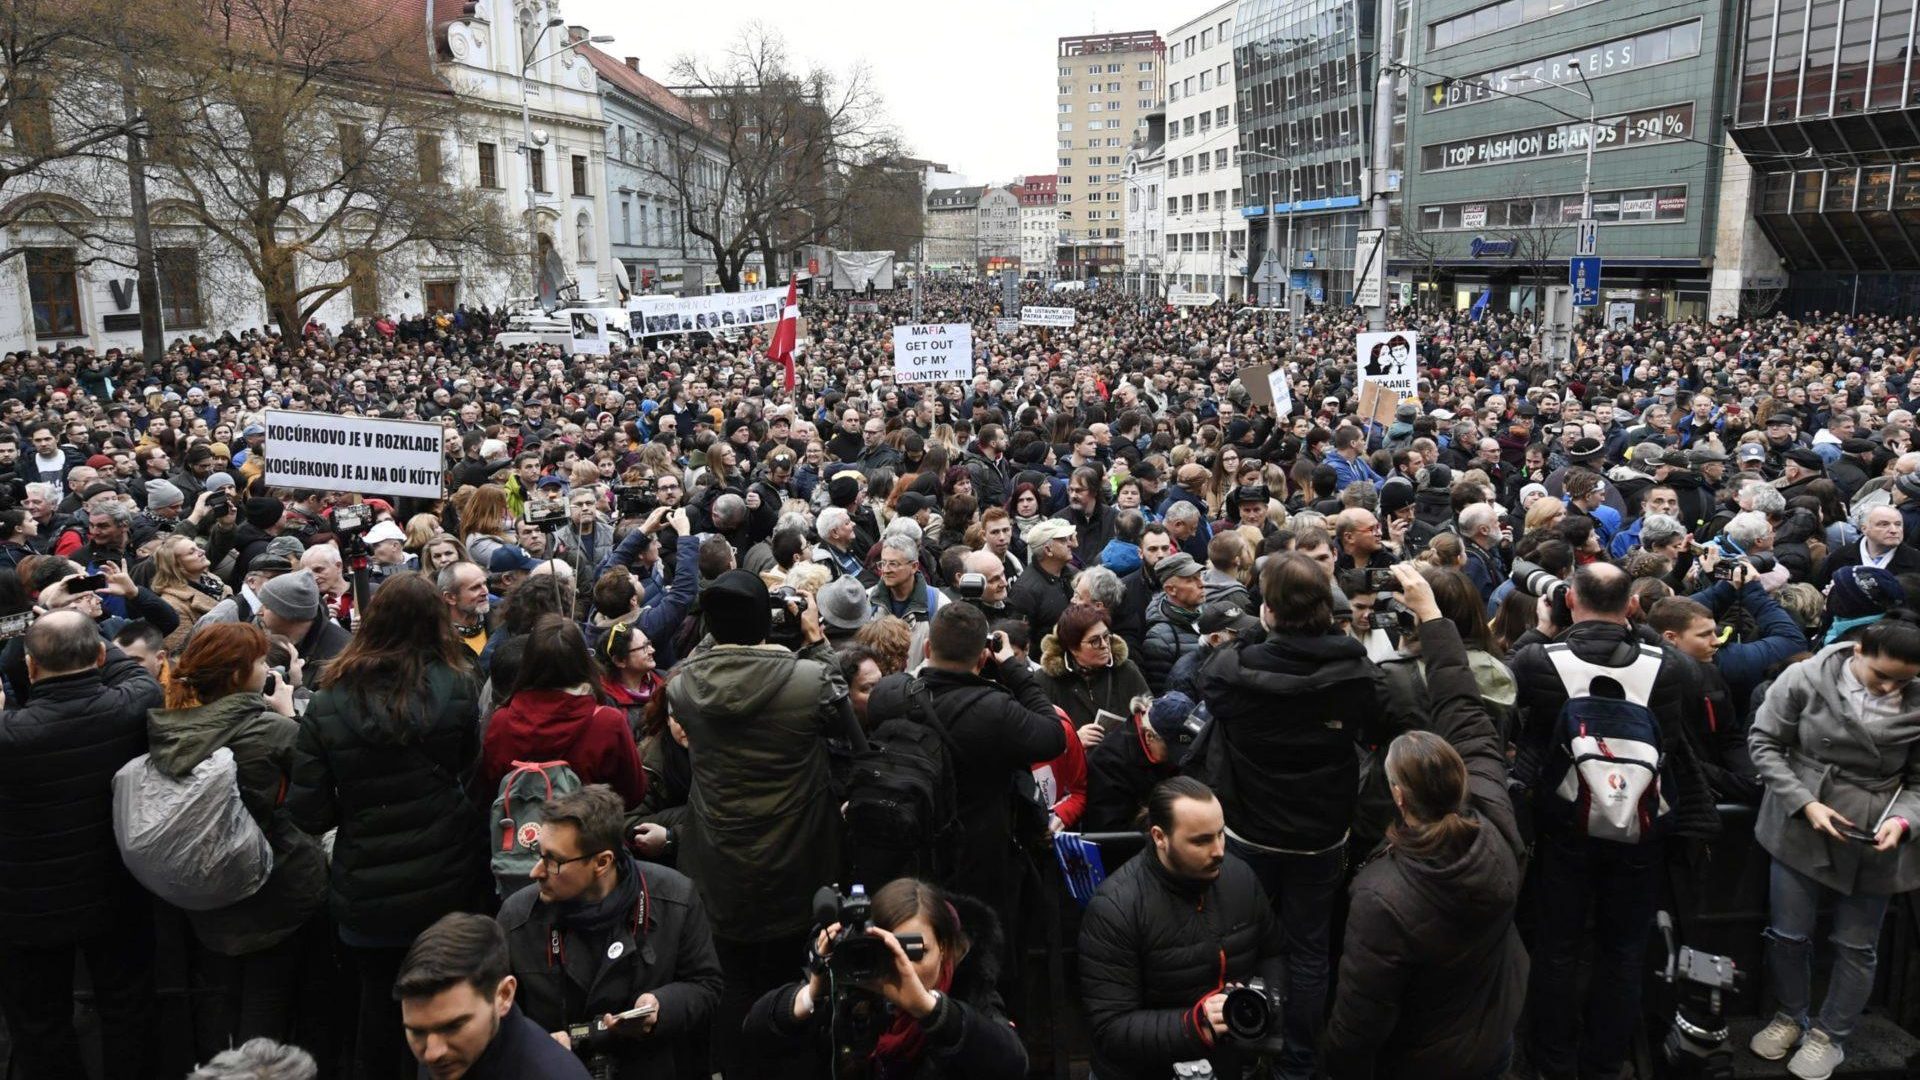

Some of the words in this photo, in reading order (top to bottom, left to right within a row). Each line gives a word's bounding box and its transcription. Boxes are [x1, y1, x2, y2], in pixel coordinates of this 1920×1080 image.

[1450, 143, 1475, 164] TOP
[1478, 135, 1541, 161] FASHION
[1547, 126, 1617, 151] BRANDS
[1665, 114, 1684, 135] %
[912, 326, 946, 335] MAFIA
[905, 341, 927, 351] GET
[930, 340, 953, 350] OUT
[913, 356, 927, 365] OF
[931, 355, 947, 364] MY
[896, 370, 949, 381] COUNTRY
[955, 369, 966, 378] !!!
[268, 424, 346, 446] KOCÚRKOVO
[348, 431, 361, 447] JE
[363, 432, 373, 448] V
[375, 433, 439, 453] ROZKLADE
[265, 456, 338, 479] KOCÚRKOVO
[341, 464, 353, 480] JE
[355, 465, 369, 481] AJ
[371, 466, 387, 482] NA
[390, 466, 407, 484] OÚ
[409, 467, 441, 486] KÚTY
